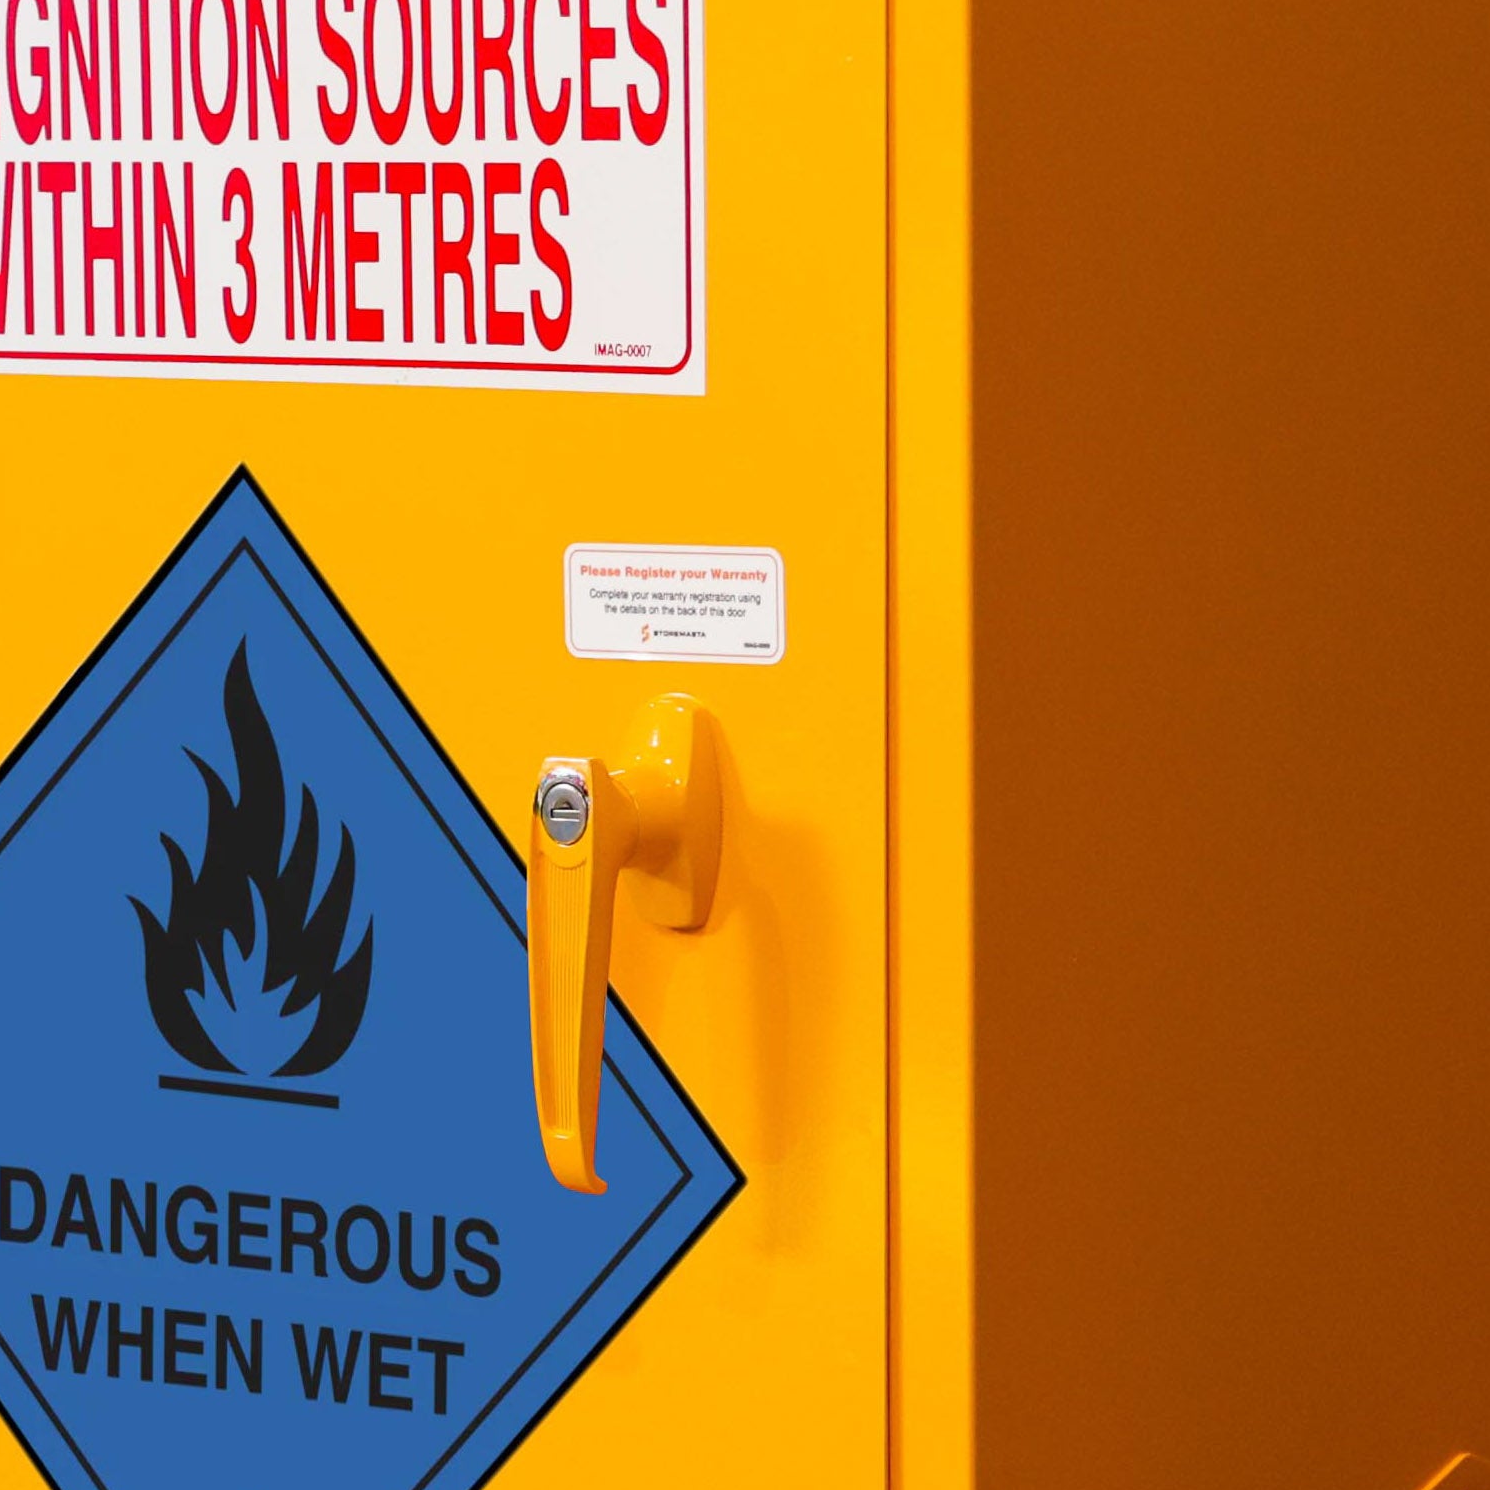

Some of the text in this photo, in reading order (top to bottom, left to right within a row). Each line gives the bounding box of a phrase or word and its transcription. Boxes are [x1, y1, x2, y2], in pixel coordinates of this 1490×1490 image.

[220, 166, 257, 344] 3
[281, 157, 573, 353] METRES
[594, 343, 652, 358] IMAG-0007
[580, 565, 768, 583] Please Register your Warranty
[589, 588, 761, 605] Complete your warranty registration using
[604, 603, 747, 618] the details on the back of this door
[31, 1293, 466, 1415] WHEN WET
